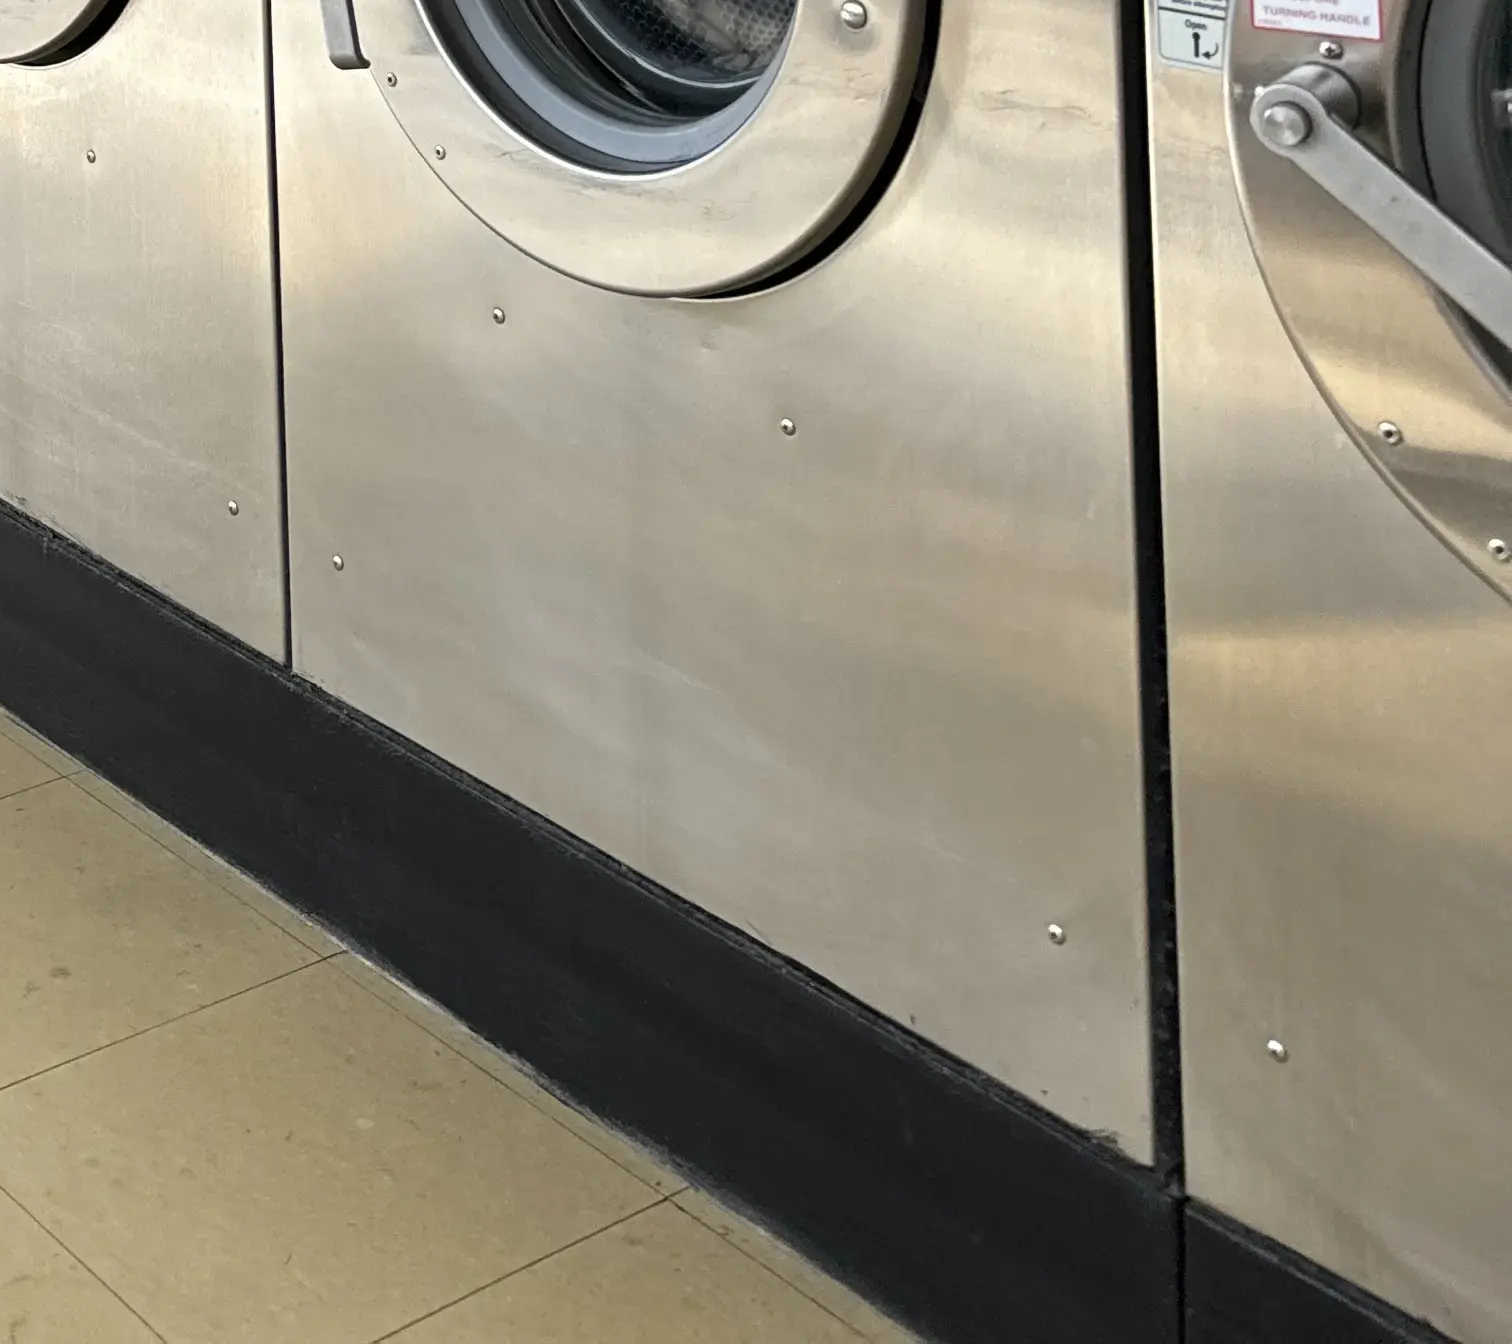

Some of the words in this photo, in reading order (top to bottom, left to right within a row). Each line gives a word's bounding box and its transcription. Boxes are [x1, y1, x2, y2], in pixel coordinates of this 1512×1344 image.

[1184, 18, 1207, 30] Open
[1263, 5, 1317, 21] TURNING
[1319, 12, 1371, 27] HANDLE
